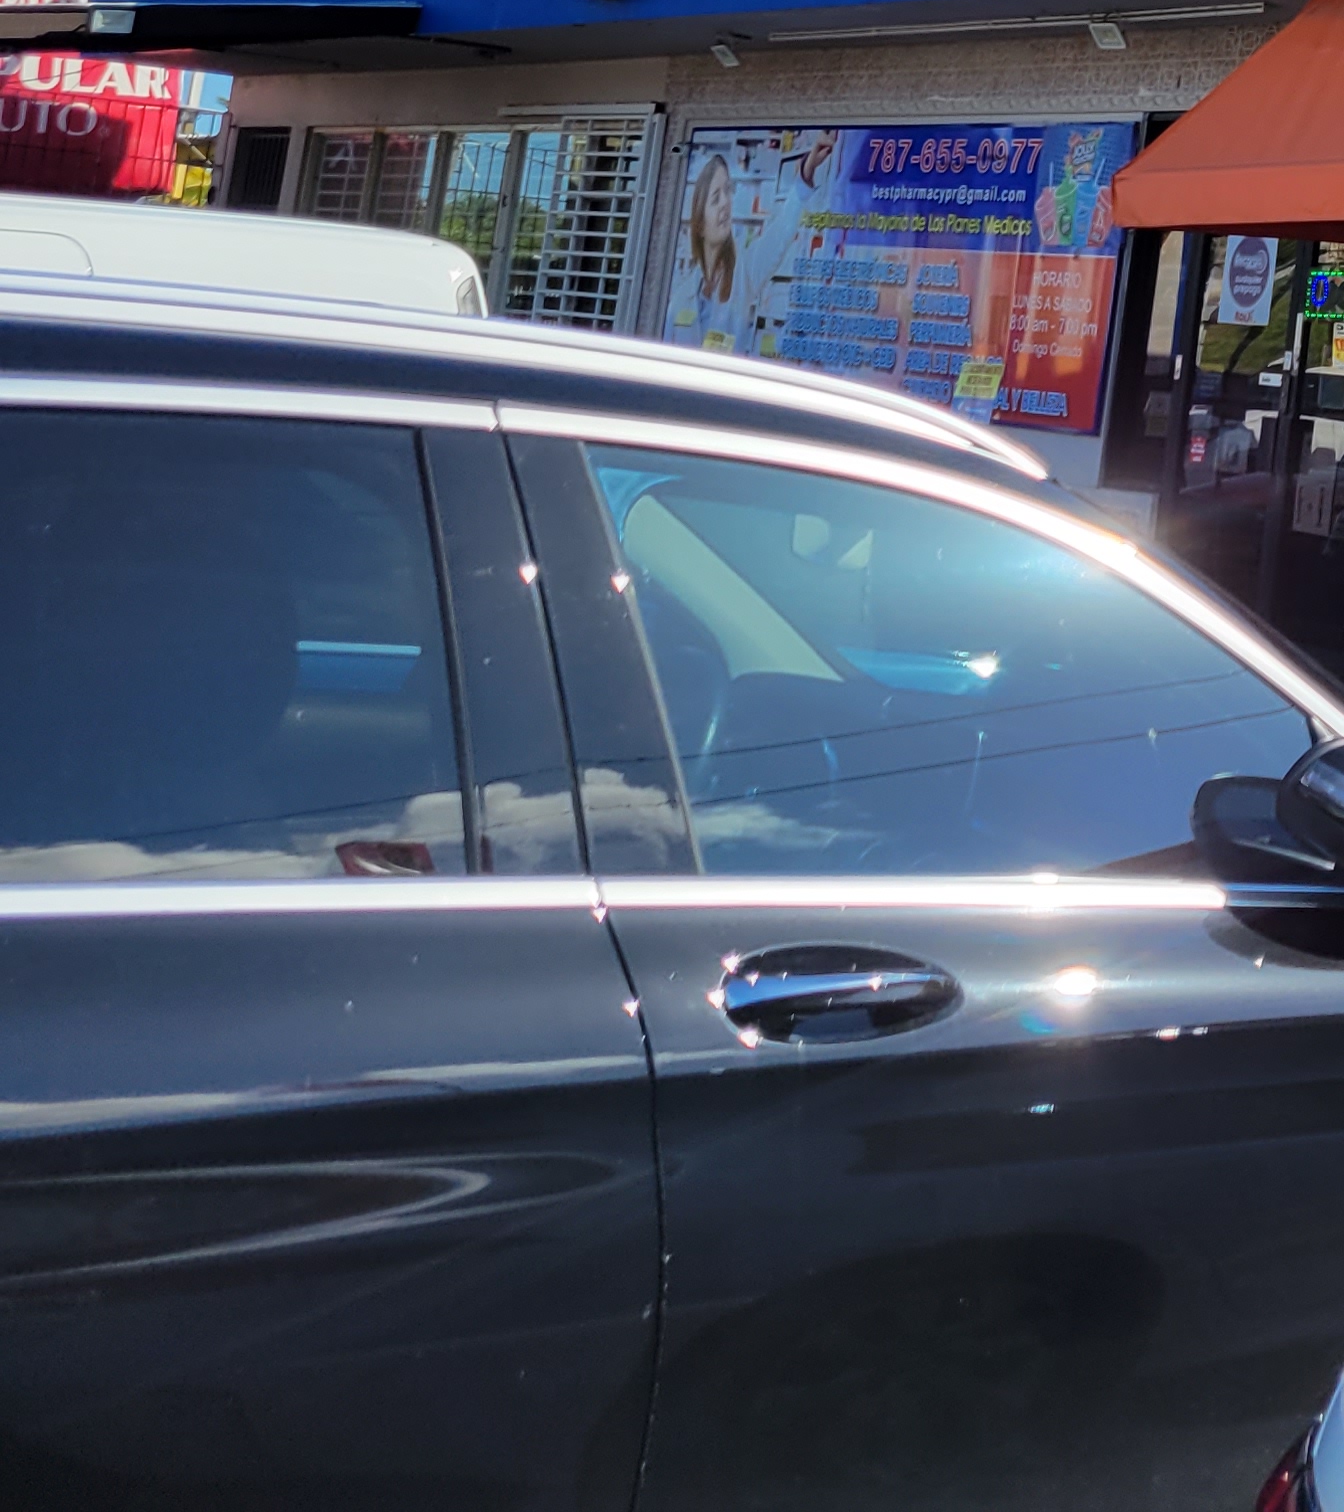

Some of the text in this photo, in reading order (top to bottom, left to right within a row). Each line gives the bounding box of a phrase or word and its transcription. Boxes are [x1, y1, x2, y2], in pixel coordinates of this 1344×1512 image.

[868, 138, 1044, 174] 787-655-0977
[872, 184, 1027, 205] bestpharmacypr@gmail.com
[1033, 270, 1082, 288] HORARIO
